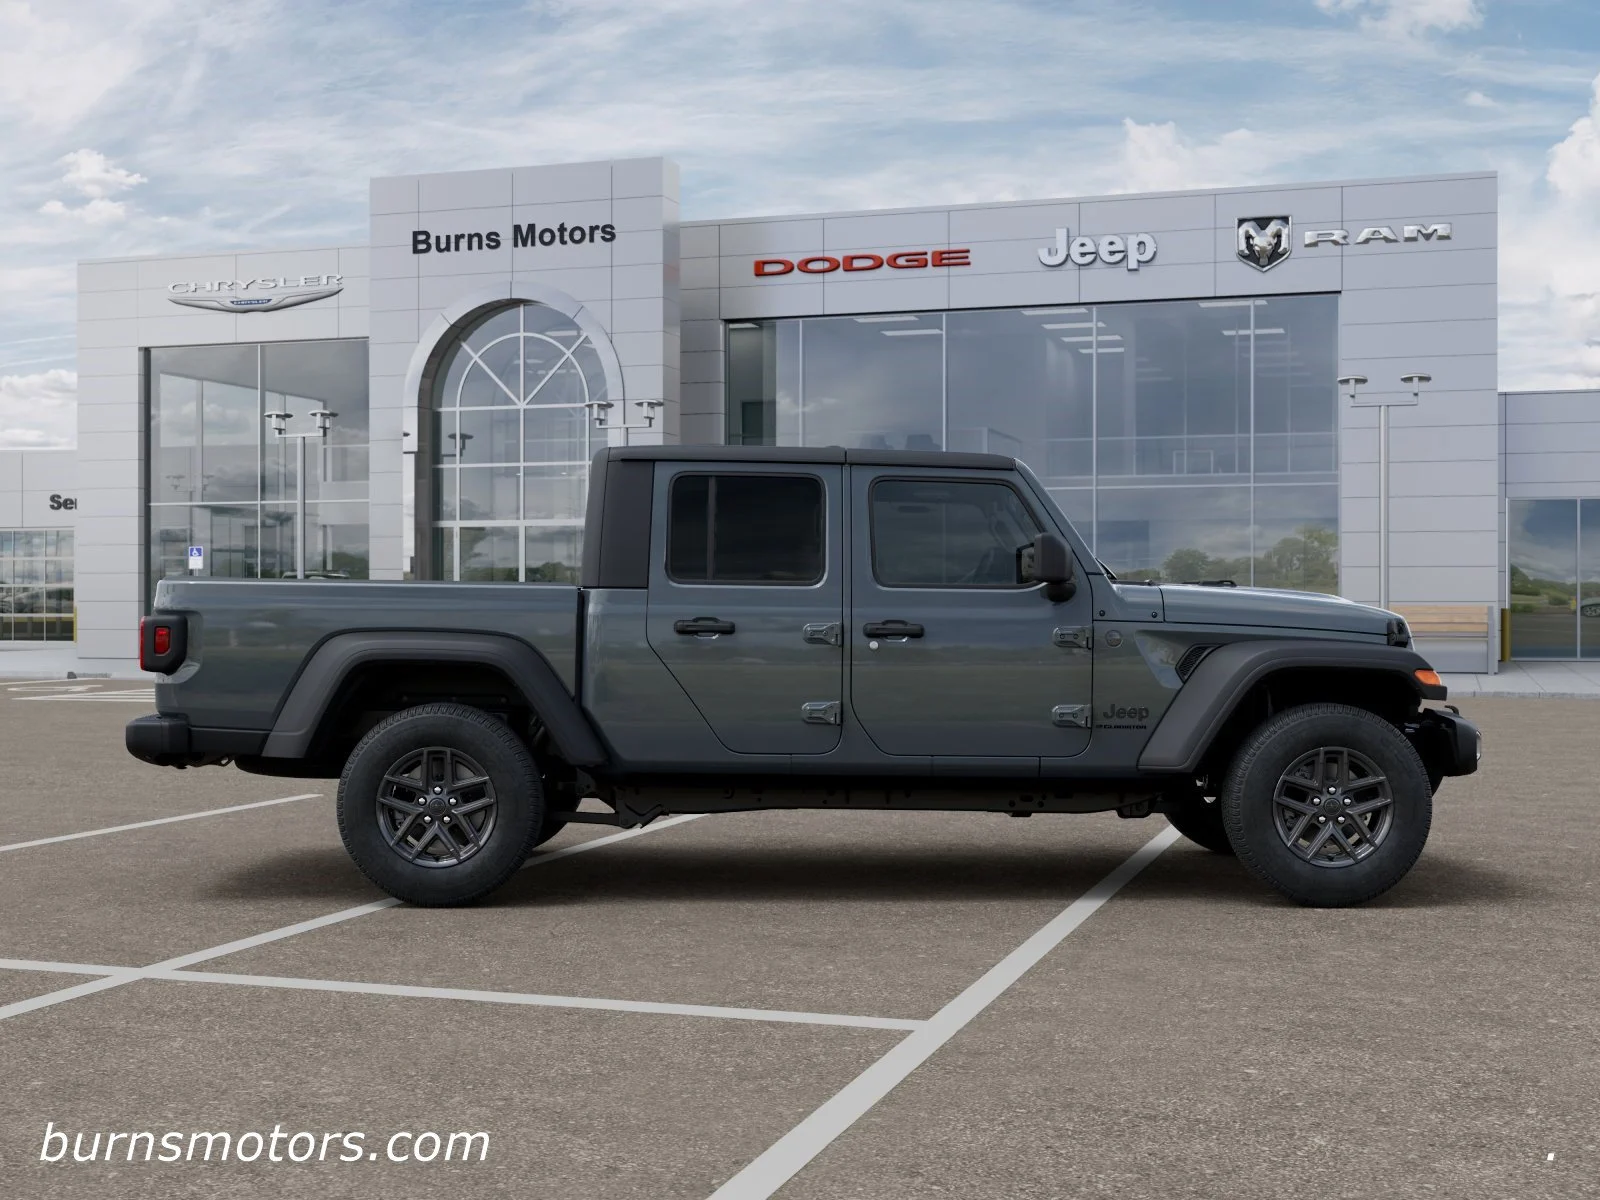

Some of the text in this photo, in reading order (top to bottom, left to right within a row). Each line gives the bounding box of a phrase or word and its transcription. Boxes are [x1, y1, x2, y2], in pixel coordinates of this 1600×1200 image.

[411, 222, 617, 254] Burns Motors
[1303, 222, 1453, 248] RAM
[753, 248, 971, 277] DODGE
[1037, 226, 1158, 272] Jeep
[167, 273, 344, 293] CHRYSLER
[1102, 703, 1150, 721] Jeep
